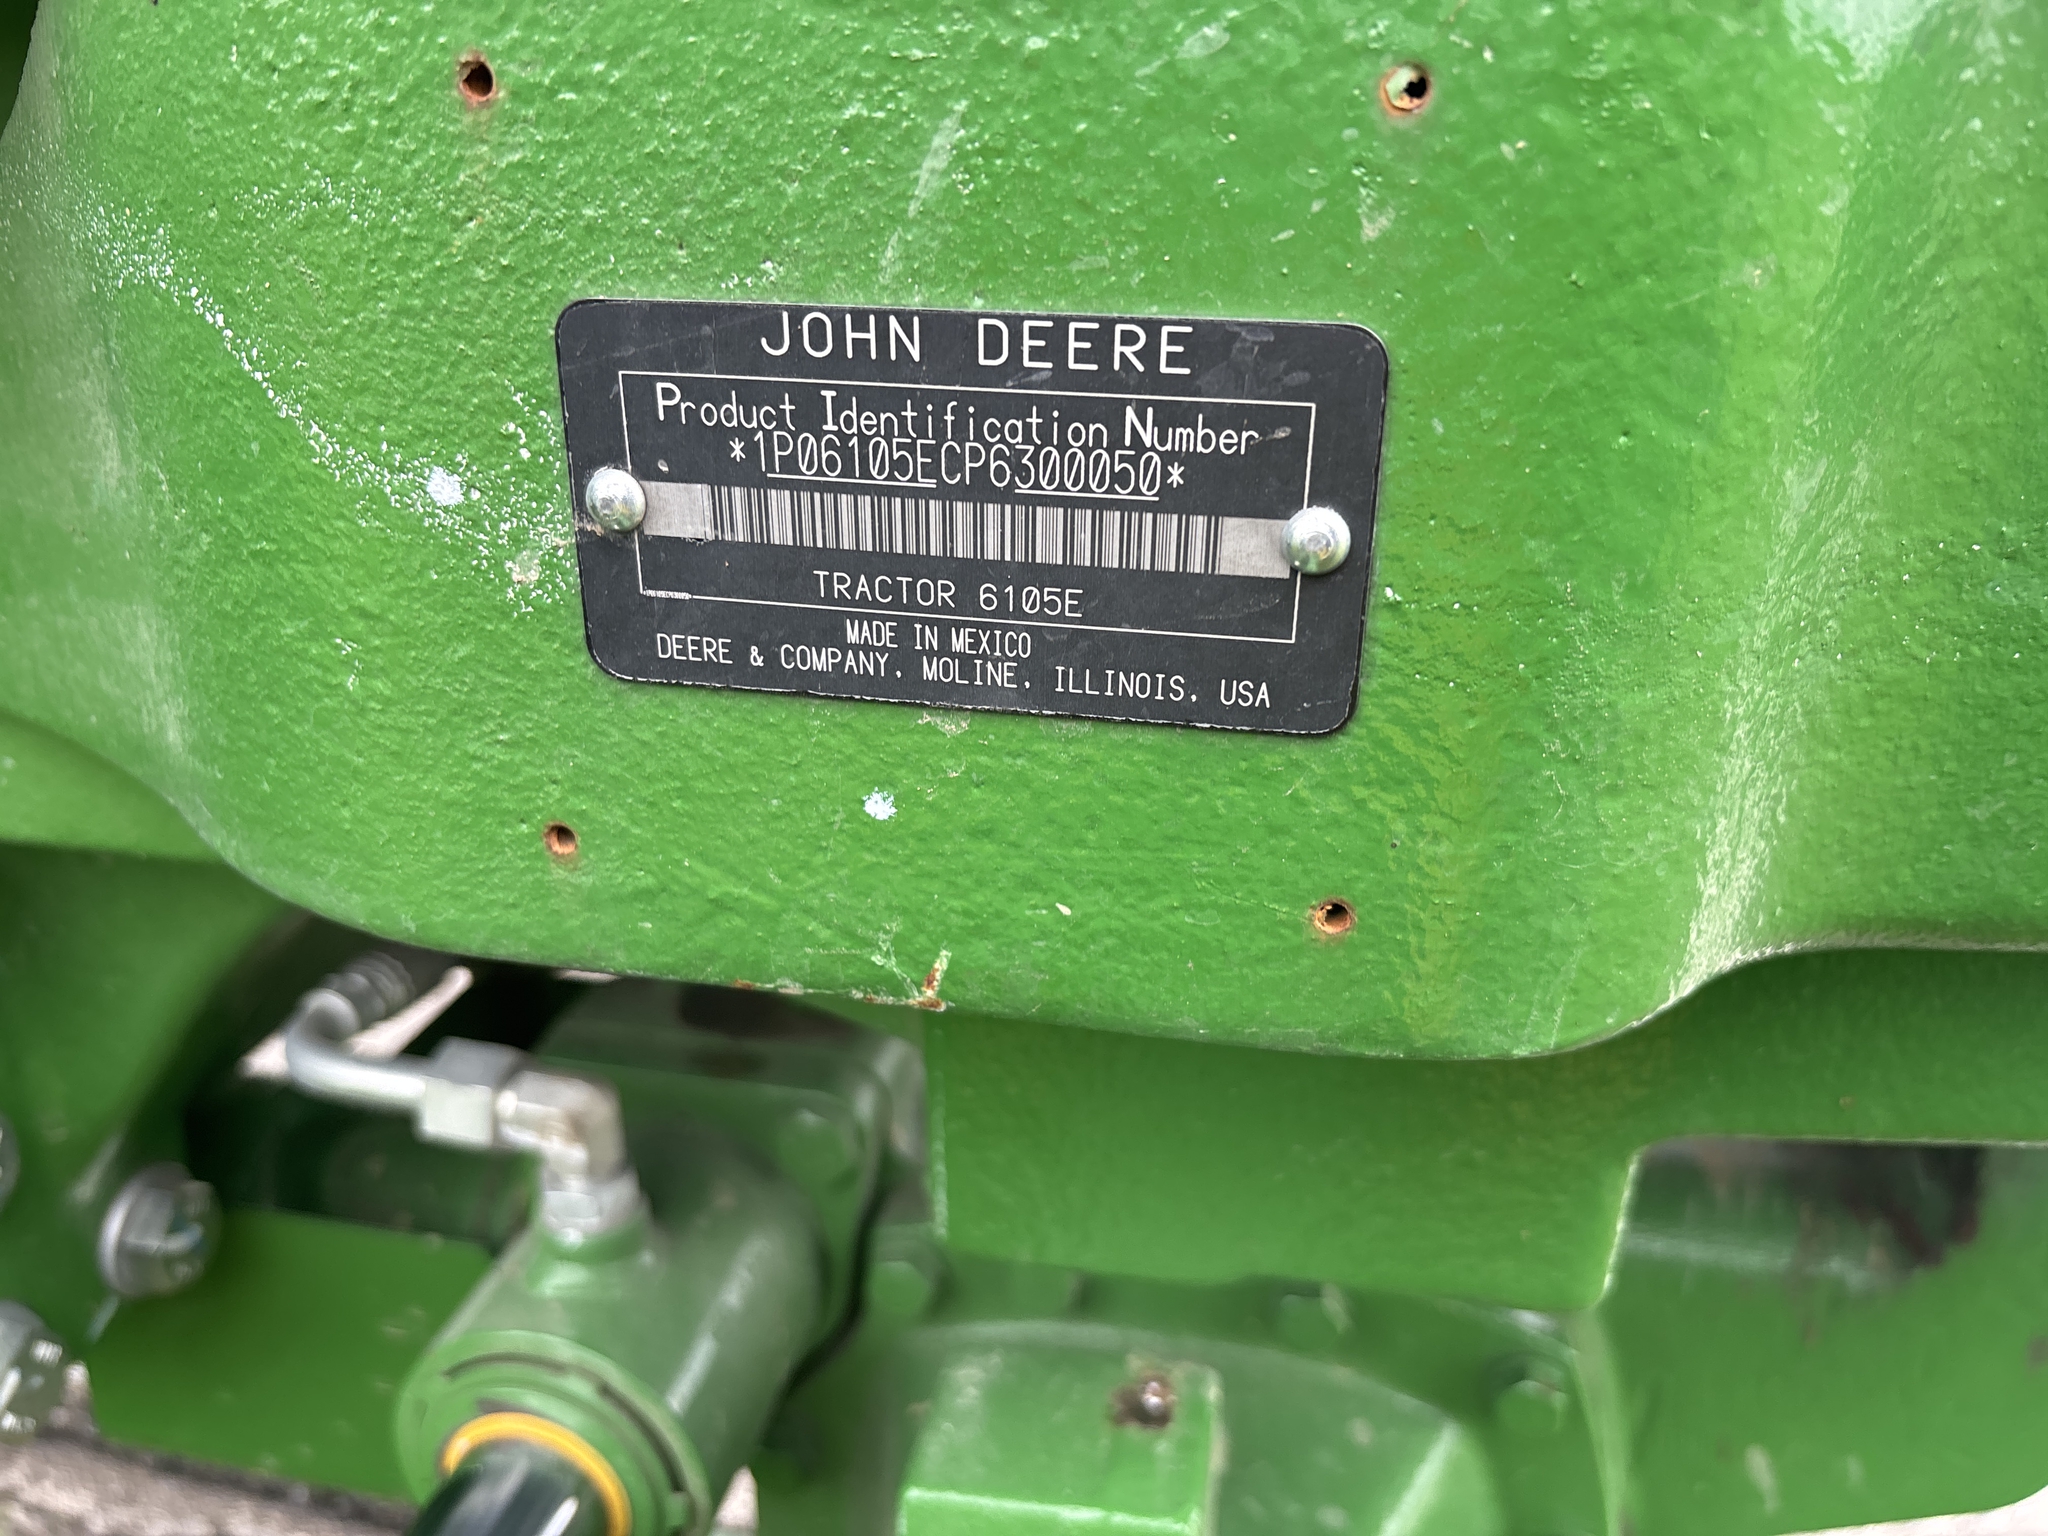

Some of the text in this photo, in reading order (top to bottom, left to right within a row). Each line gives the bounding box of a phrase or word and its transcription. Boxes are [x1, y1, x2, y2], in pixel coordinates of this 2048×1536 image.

[760, 311, 1194, 375] JOHN DEERE
[656, 382, 1258, 455] Product Identification Number
[813, 569, 1084, 618] TRACTOR 6105E
[845, 617, 1032, 659] MADE IN MEXICO
[655, 632, 734, 664] DEERE
[749, 645, 765, 667] &
[1219, 680, 1272, 709] USA
